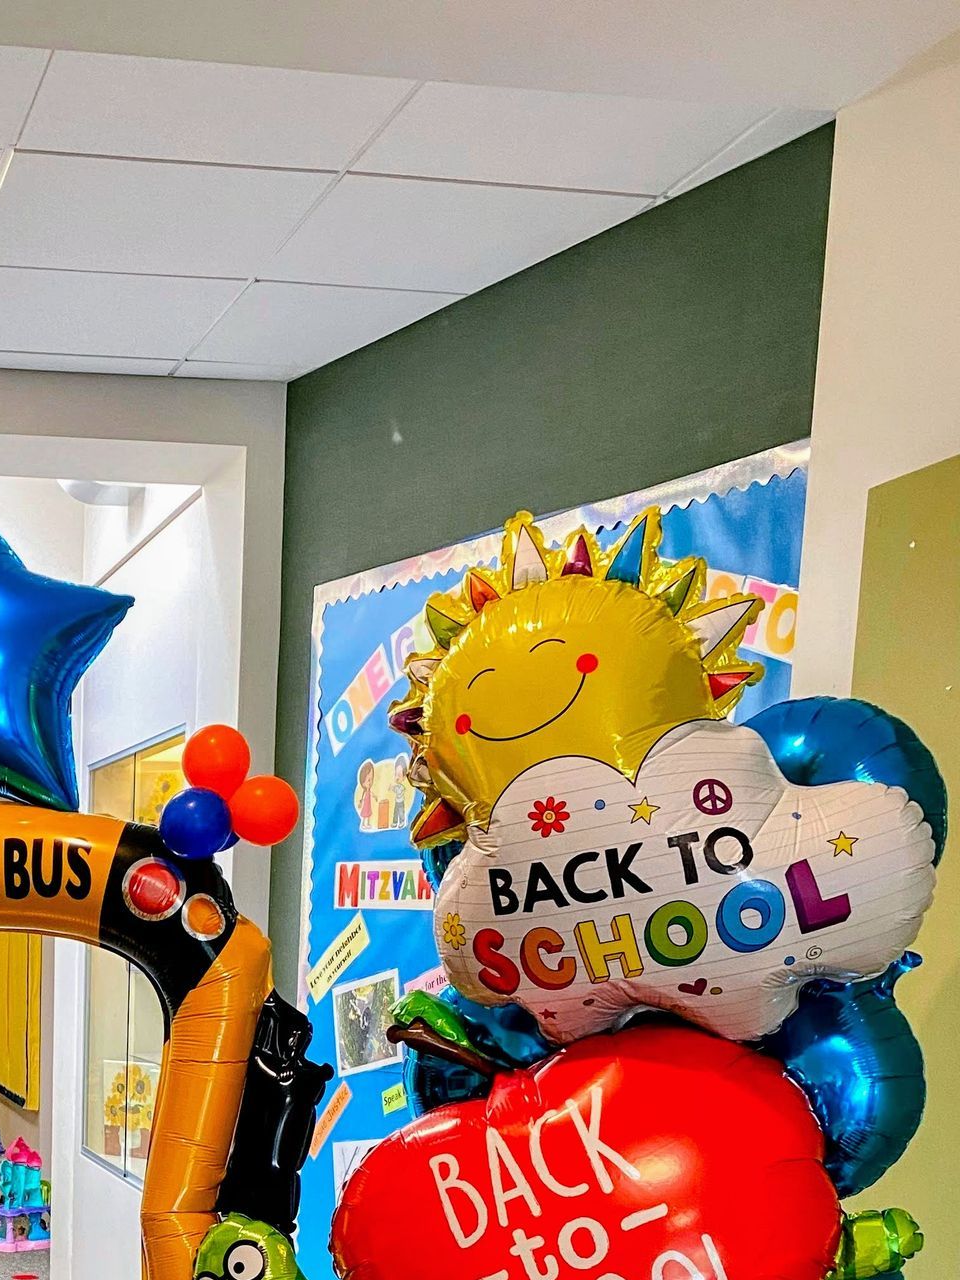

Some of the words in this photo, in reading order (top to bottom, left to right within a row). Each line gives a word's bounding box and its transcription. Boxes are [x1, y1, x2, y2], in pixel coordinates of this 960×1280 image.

[331, 650, 391, 743] ONE
[3, 837, 93, 901] BUS
[488, 841, 653, 917] BACK
[666, 826, 754, 886] TO
[472, 858, 852, 997] SCHOOL
[428, 1085, 642, 1250] BACK
